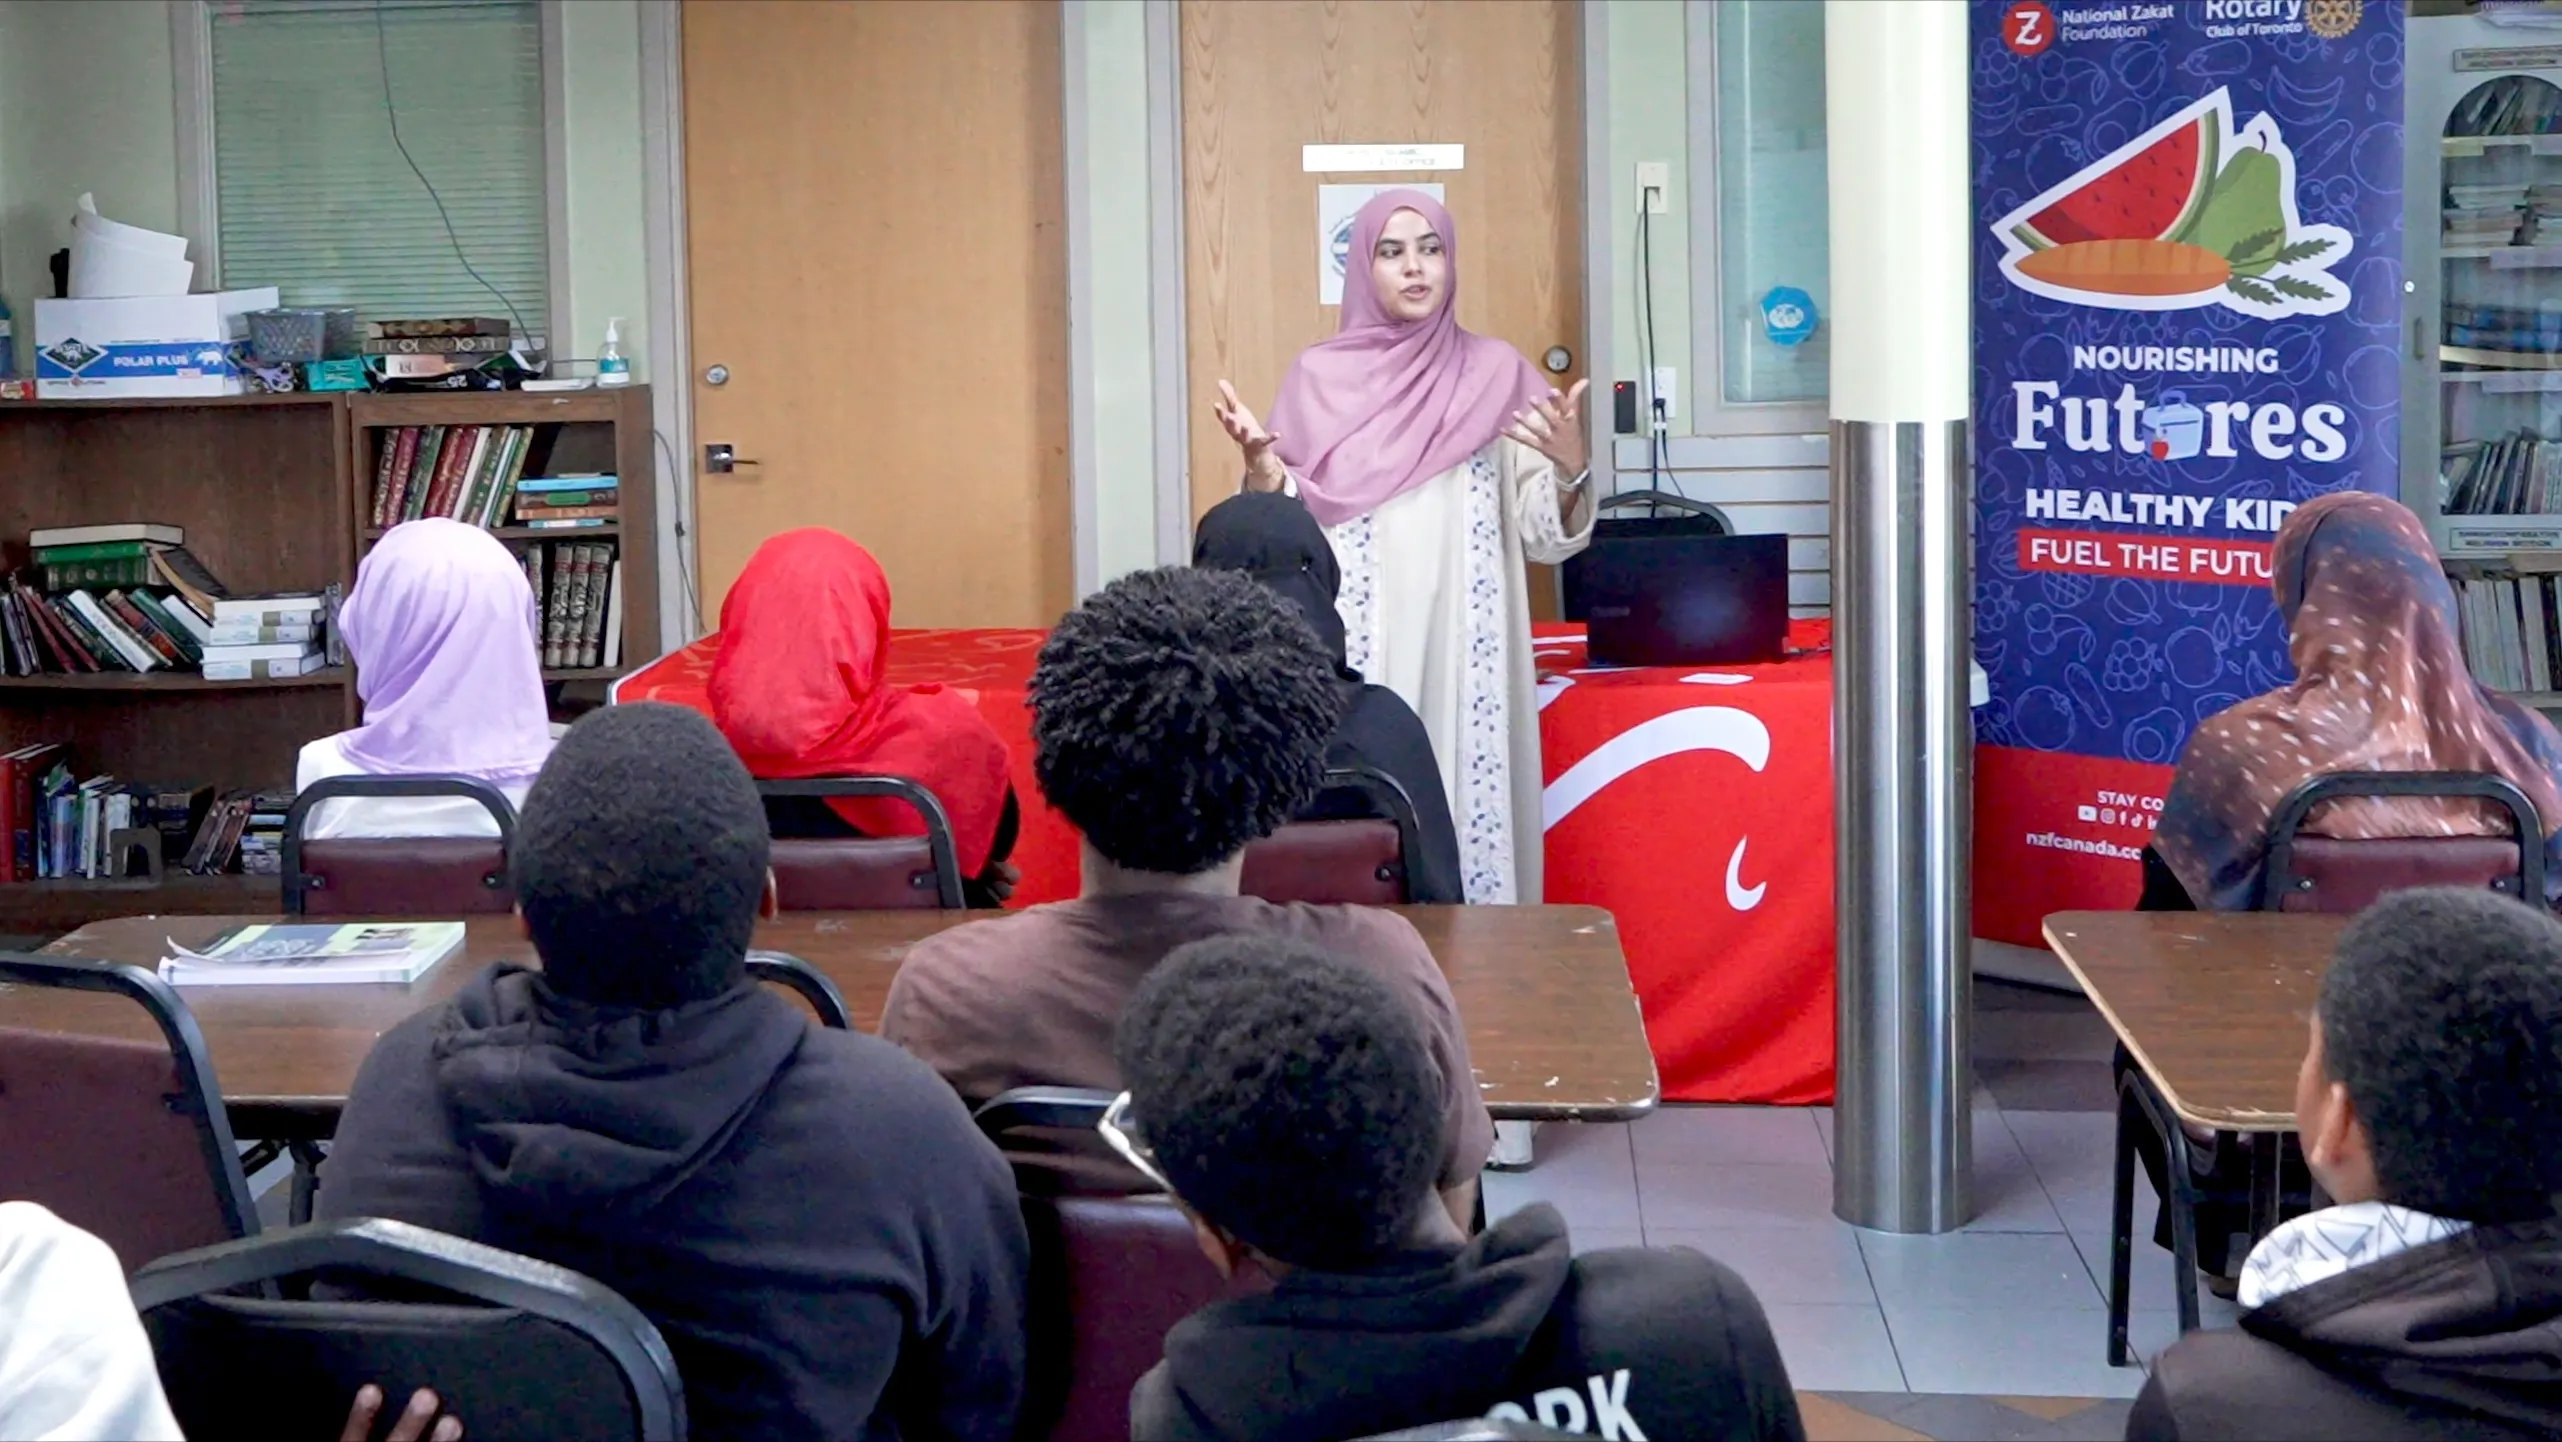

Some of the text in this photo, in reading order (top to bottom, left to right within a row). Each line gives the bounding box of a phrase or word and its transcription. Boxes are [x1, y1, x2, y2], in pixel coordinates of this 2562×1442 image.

[2062, 4, 2174, 24] National Zakat
[2062, 25, 2147, 42] Foundation
[2205, 22, 2303, 38] Club of Toronto
[2073, 345, 2279, 373] NOURISHING
[2011, 380, 2347, 462] Futres
[2025, 488, 2300, 532] HEALTHY KID
[2030, 537, 2274, 578] FUEL THE FUTU
[2097, 790, 2137, 807] STAY
[2025, 832, 2143, 860] nzfcanada.co
[1483, 1368, 1648, 1442] RK
